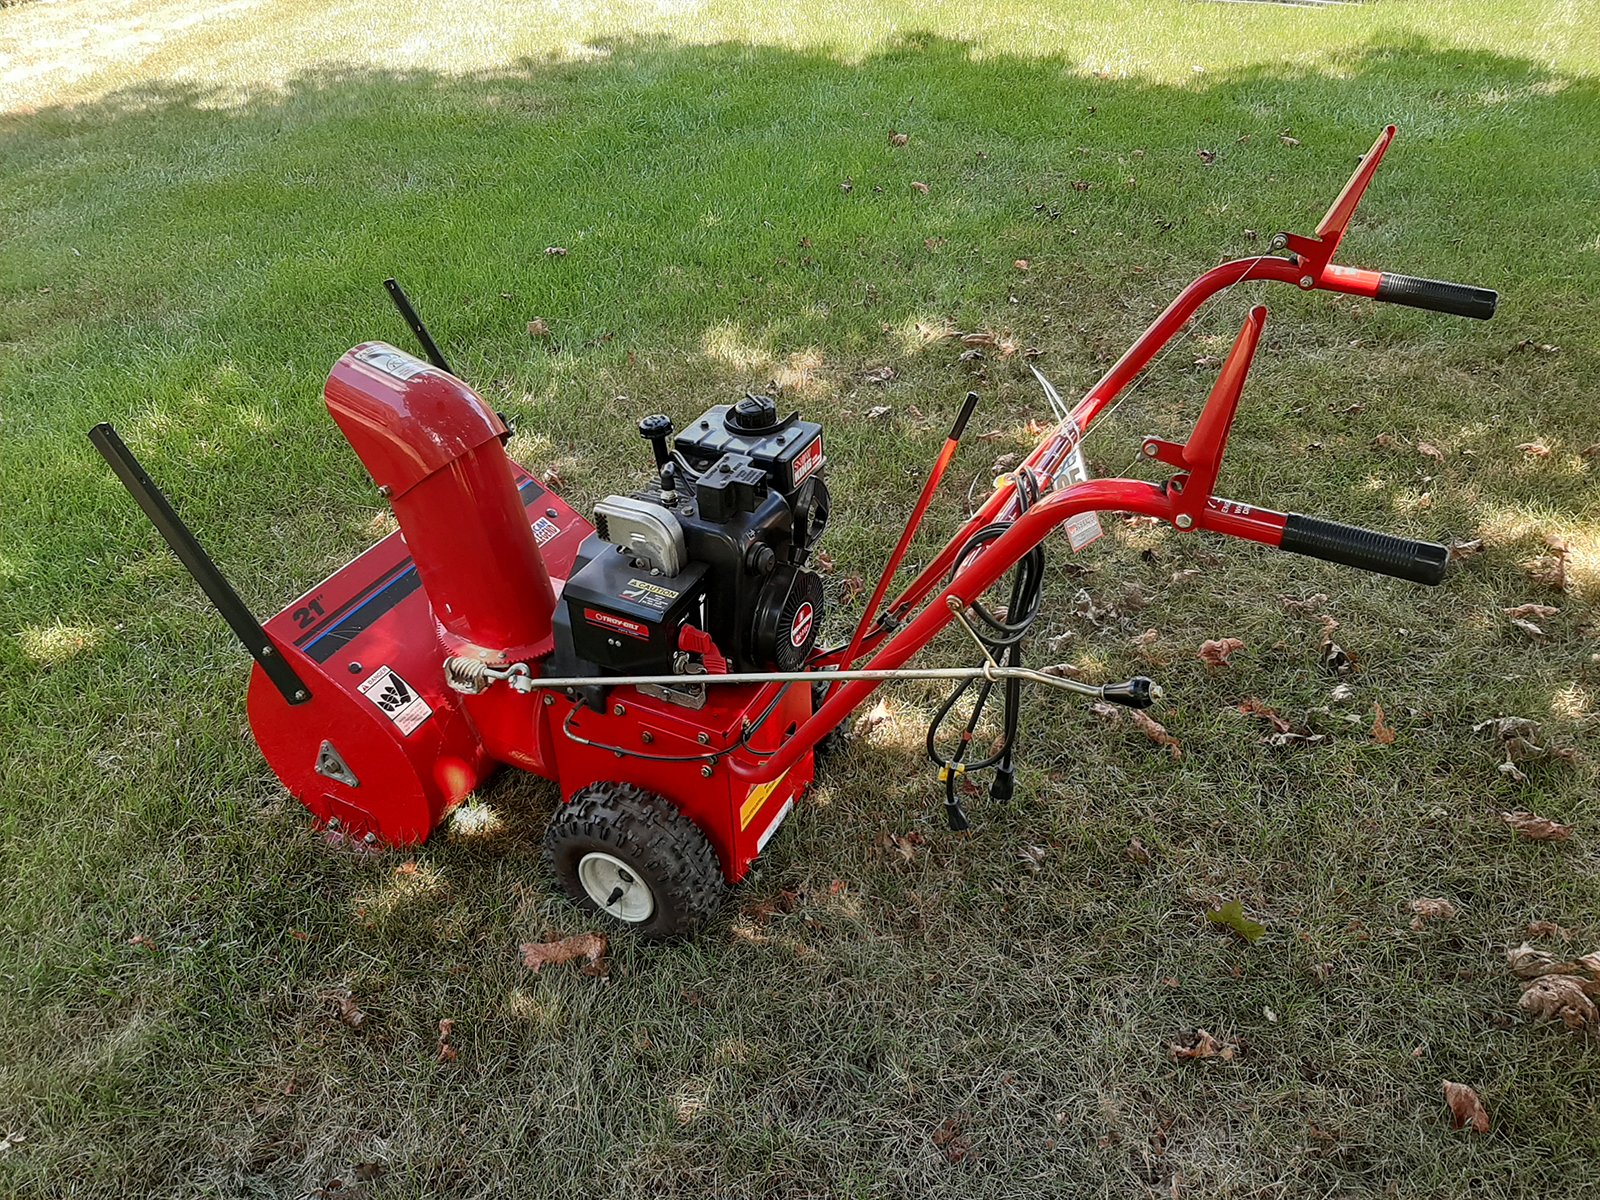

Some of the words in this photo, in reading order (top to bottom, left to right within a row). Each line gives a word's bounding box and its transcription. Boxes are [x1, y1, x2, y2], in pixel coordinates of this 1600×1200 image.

[638, 582, 677, 598] CAUTION
[292, 594, 325, 629] 21"
[367, 667, 388, 685] DANGER
